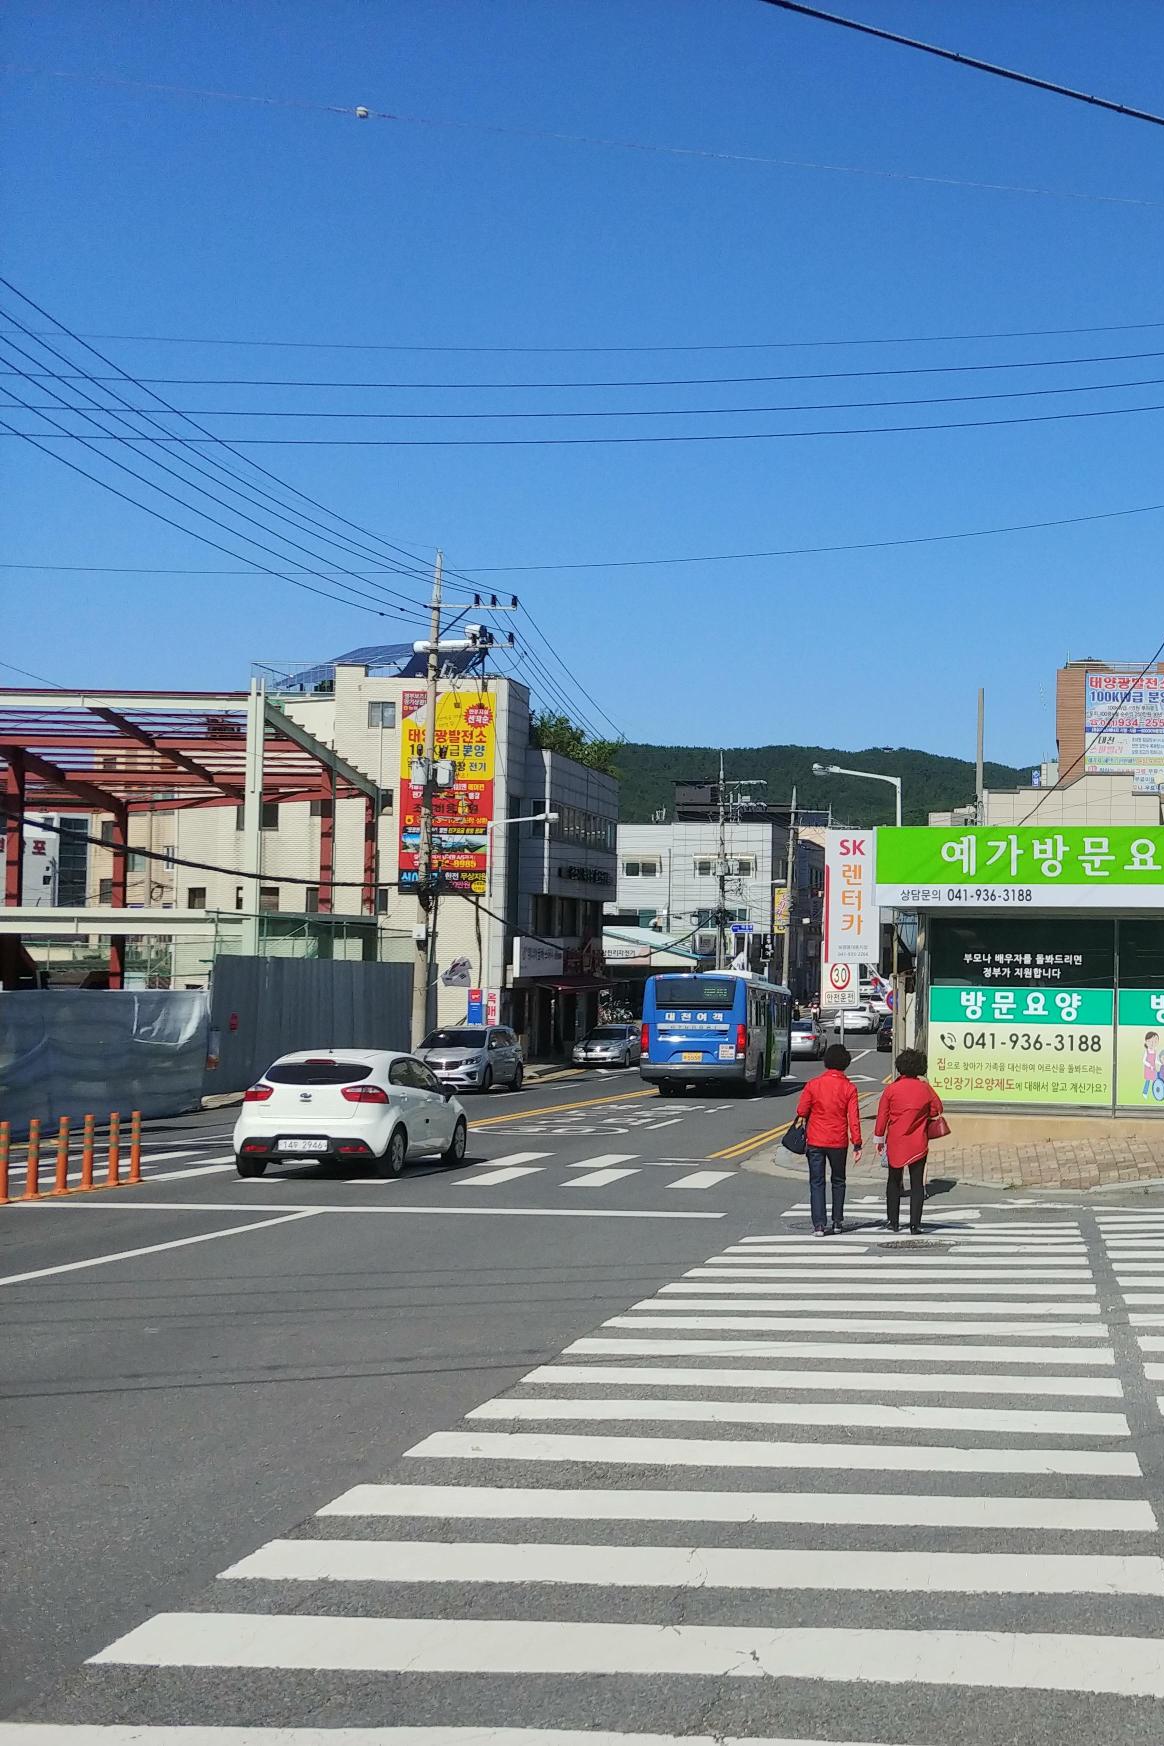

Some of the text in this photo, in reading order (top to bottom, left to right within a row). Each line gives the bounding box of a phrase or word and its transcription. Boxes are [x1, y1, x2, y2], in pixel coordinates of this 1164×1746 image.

[838, 839, 866, 856] SK
[840, 864, 863, 936] 렌터카
[900, 888, 1033, 902] 상담문의 041-936-3188
[963, 953, 1083, 965] 부모나 배우자를 돌봐드리면
[833, 968, 847, 983] 30
[983, 967, 1062, 979] 정부가 지원합니다
[960, 991, 1083, 1021] 방문요양
[963, 1032, 1102, 1052] 041-936-3188
[936, 1058, 961, 1071] 집으로
[962, 1061, 984, 1071] 찾아가
[985, 1062, 1006, 1072] 가족을
[1007, 1062, 1036, 1073] 대신하여
[1037, 1063, 1065, 1074] 어르신을
[933, 1077, 1108, 1094] 노인장기요양제도에 대해서 알고 계신가요?
